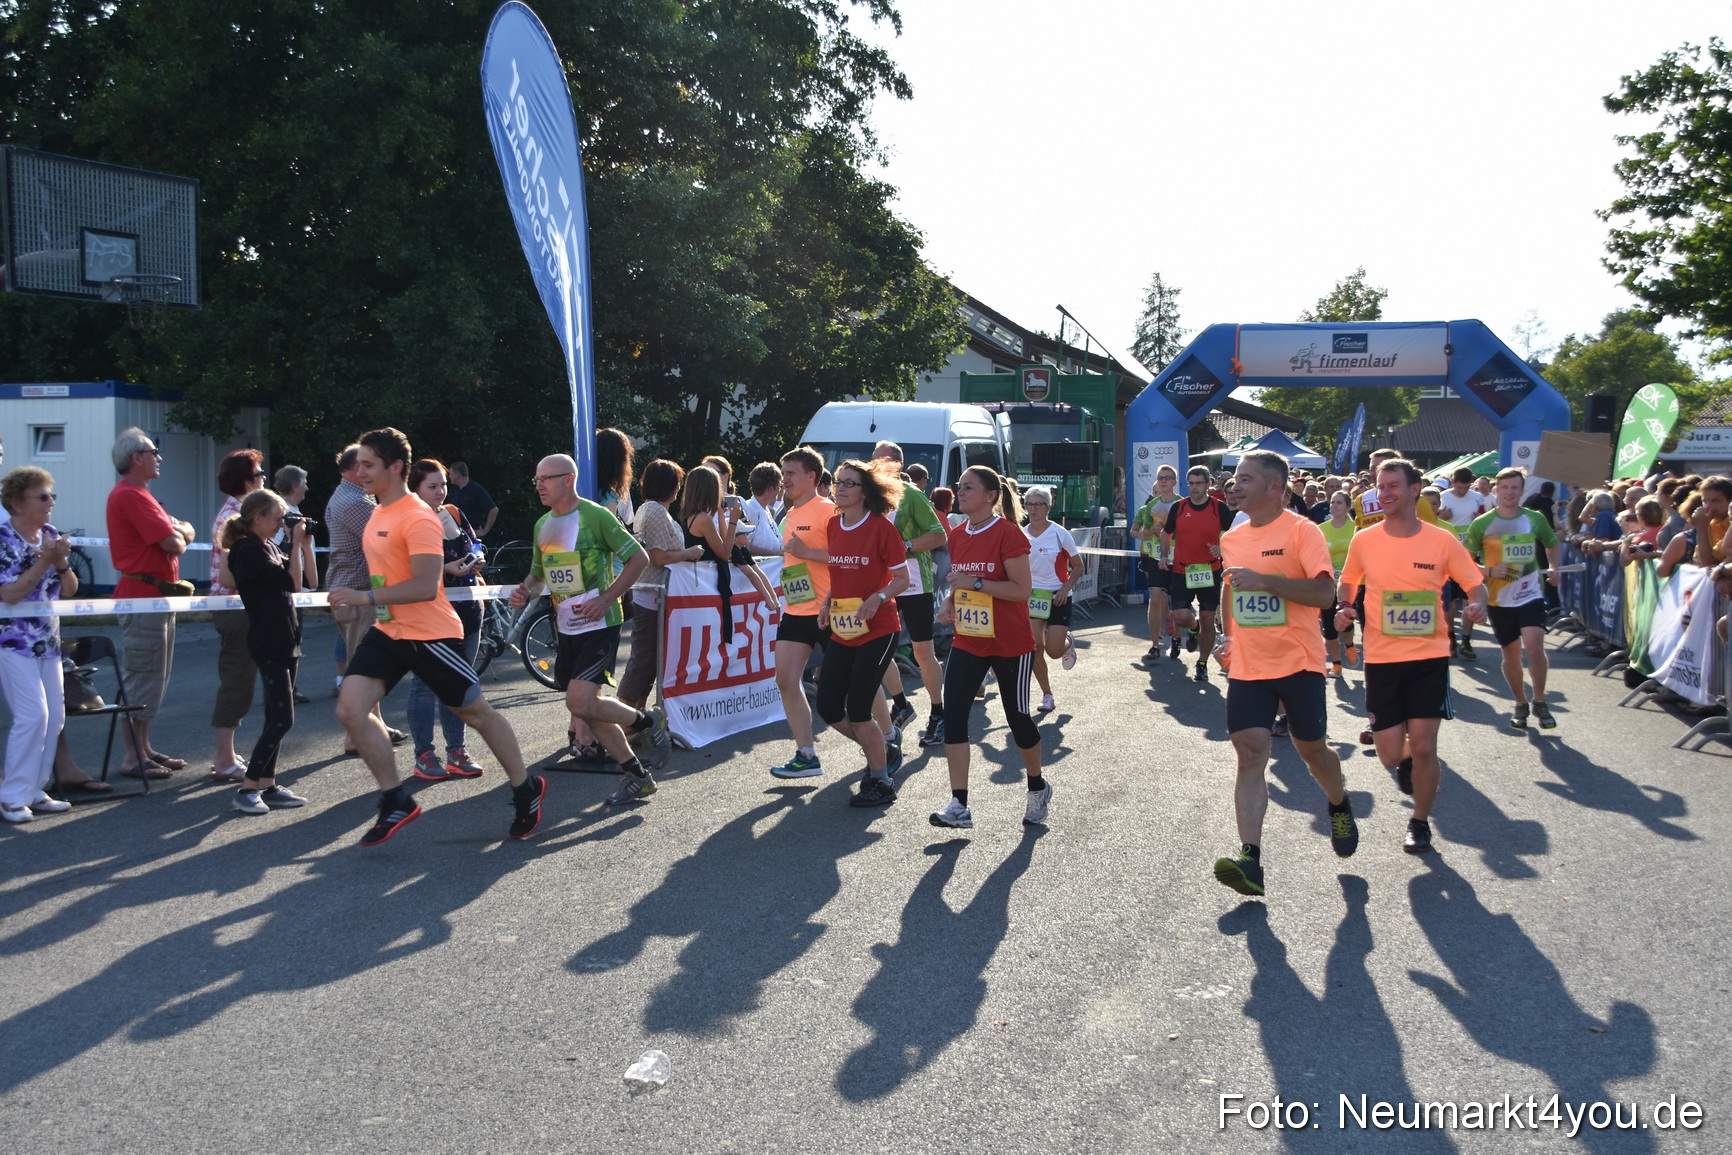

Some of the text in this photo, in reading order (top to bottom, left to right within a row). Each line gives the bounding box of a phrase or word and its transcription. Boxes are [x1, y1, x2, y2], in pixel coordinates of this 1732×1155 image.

[1320, 353, 1398, 368] firmenlauf
[1174, 382, 1214, 390] Fischer
[1643, 419, 1668, 446] AOK
[1688, 432, 1721, 441] Jura
[1618, 437, 1646, 466] AOK
[1261, 549, 1284, 557] THULE
[1505, 545, 1533, 557] 1003
[951, 562, 986, 572] EUMARKT
[1413, 562, 1435, 570] THULE
[550, 569, 574, 583] 995
[1188, 572, 1211, 582] 1376
[783, 579, 810, 595] 1448
[1236, 596, 1280, 613] 1450
[832, 615, 863, 629] 1414
[957, 607, 989, 626] 1413
[1387, 609, 1431, 625] 1449
